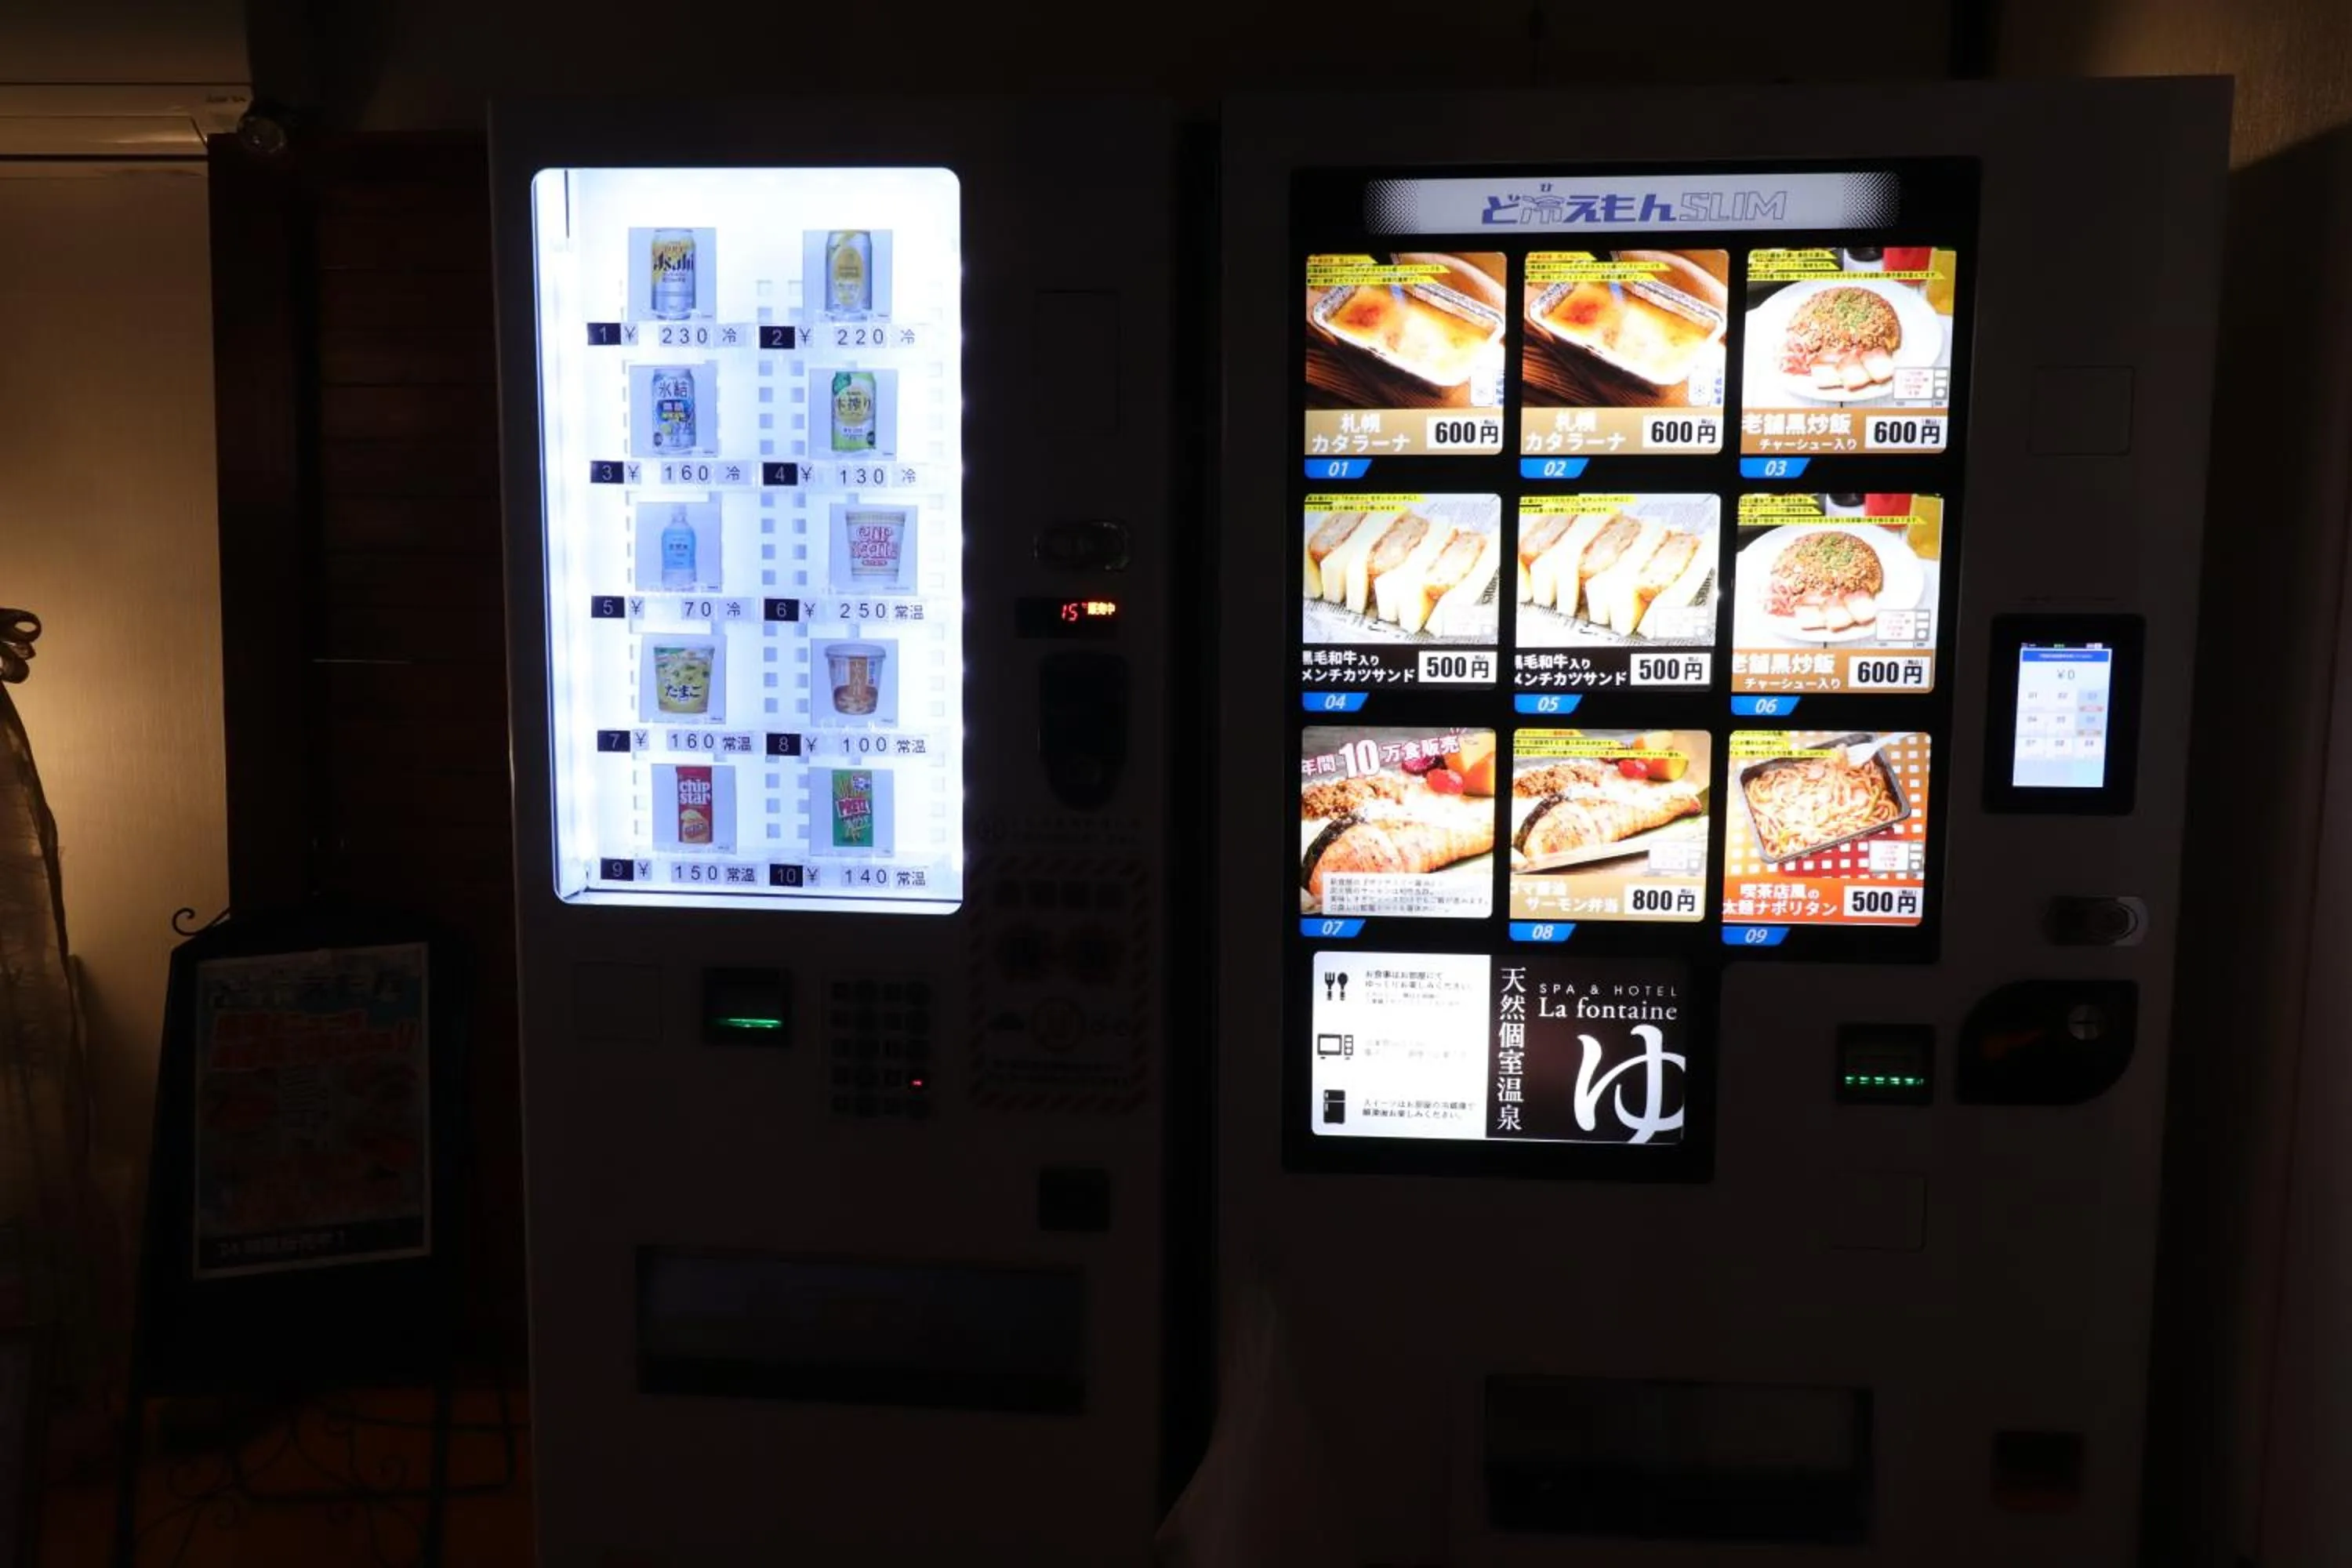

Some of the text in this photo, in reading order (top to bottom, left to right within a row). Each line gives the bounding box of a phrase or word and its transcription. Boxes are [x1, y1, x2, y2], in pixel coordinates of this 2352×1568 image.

[1679, 191, 1788, 222] SLIM
[652, 251, 695, 272] Asahi
[598, 326, 609, 343] 1
[662, 328, 708, 344] 230
[771, 329, 782, 346] 2
[837, 328, 884, 346] 220
[1435, 420, 1499, 445] 600円
[1650, 420, 1717, 445] 600円
[1874, 422, 1940, 445] 600円
[1312, 434, 1411, 452] カタラーナ
[1525, 433, 1627, 452] カタラーナ
[1759, 437, 1858, 452] チャーシュー入り
[602, 465, 613, 481] 3
[665, 465, 709, 481] 160
[774, 466, 786, 481] 4
[840, 467, 885, 485] 130
[1327, 461, 1350, 477] 01
[1543, 461, 1566, 477] 02
[1764, 460, 1788, 477] 03
[603, 600, 613, 616] 5
[684, 601, 711, 618] 70
[775, 603, 787, 619] 6
[840, 603, 886, 619] 250
[1302, 667, 1415, 683] メンチカツサンド
[1427, 655, 1490, 679] 500円
[1639, 659, 1703, 681] 500円
[1857, 661, 1922, 684] 600円
[664, 682, 702, 699] たまご
[1744, 677, 1842, 690] チャーシュー入り
[1325, 695, 1346, 710] 04
[1537, 696, 1559, 712] 05
[1755, 699, 1778, 713] 06
[610, 734, 619, 749] 7
[671, 733, 714, 750] 160
[778, 737, 789, 753] 8
[842, 737, 887, 753] 100
[679, 779, 711, 796] chip
[679, 791, 711, 805] star
[612, 862, 623, 878] 9
[675, 865, 718, 881] 150
[776, 868, 797, 884] 10
[844, 869, 887, 885] 140
[1632, 889, 1697, 912] 800円
[1852, 891, 1917, 914] 500円
[1321, 921, 1343, 936] 07
[1532, 925, 1554, 940] 08
[1744, 928, 1767, 942] 09
[1539, 983, 1678, 997] SPA & HOTEL
[1538, 996, 1678, 1020] La fontaine
[1496, 967, 1526, 1131] 天然個室温泉
[1573, 1023, 1686, 1144] ゆ
